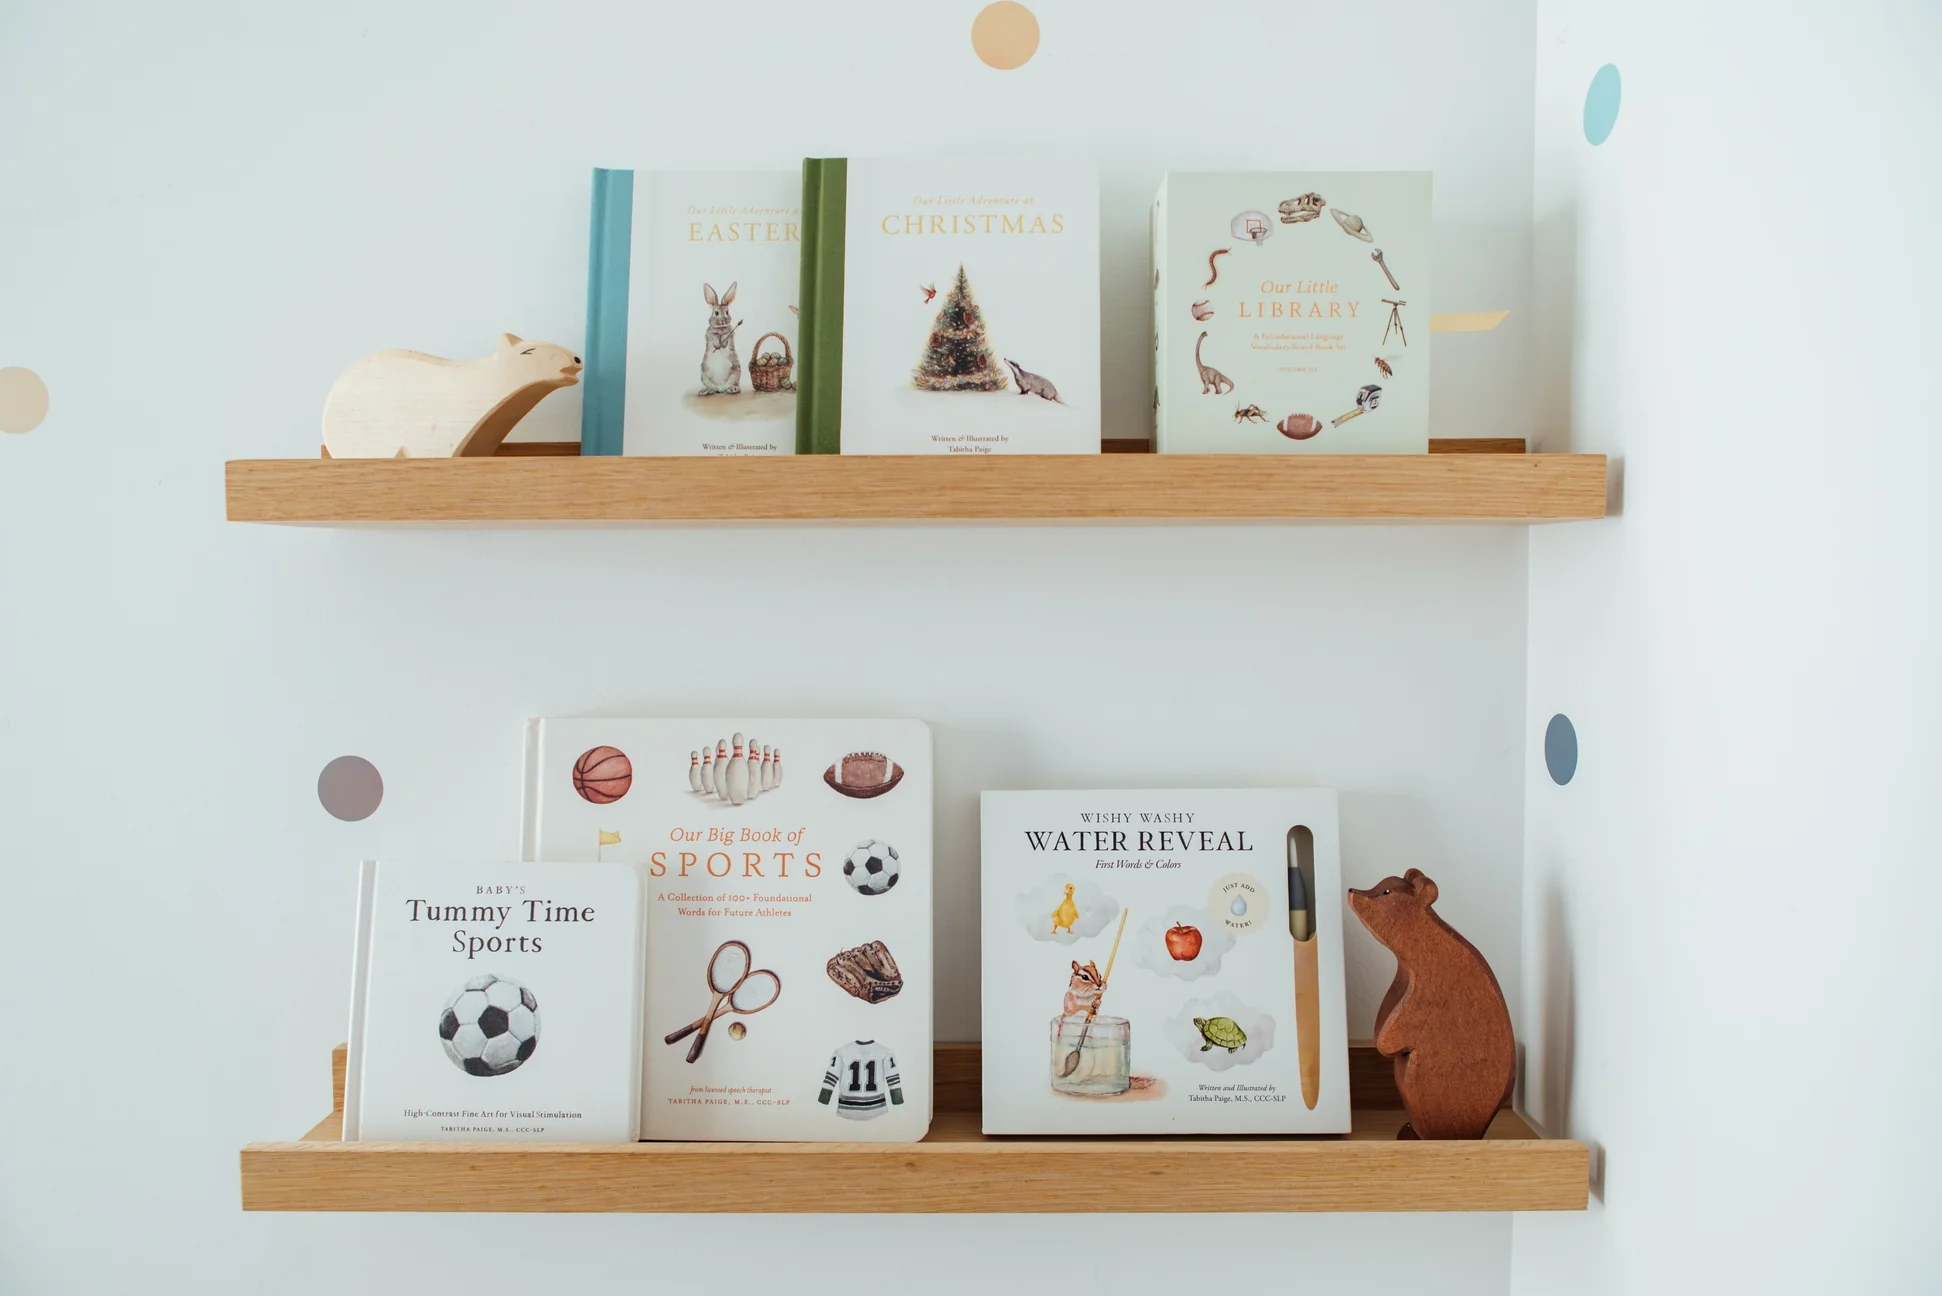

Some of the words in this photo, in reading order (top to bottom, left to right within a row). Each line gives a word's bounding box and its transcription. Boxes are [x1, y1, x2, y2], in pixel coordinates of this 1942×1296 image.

[912, 196, 934, 206] Our
[938, 196, 964, 206] Little
[968, 196, 1020, 206] Adventure
[881, 214, 1065, 235] CHRISTMAS
[688, 222, 801, 242] EASTER
[1260, 280, 1292, 294] Our
[1297, 280, 1338, 294] Little
[1238, 301, 1361, 318] LIBRARY
[975, 446, 992, 454] Paige
[1080, 813, 1132, 823] WISHY
[1140, 813, 1196, 823] WASHY
[670, 828, 703, 843] Our
[707, 828, 735, 846] Big
[739, 828, 782, 843] Book
[787, 827, 806, 846] of
[1024, 831, 1128, 852] WATER
[1138, 831, 1254, 852] REVEAL
[650, 852, 822, 878] SPORTS
[1095, 859, 1114, 869] First
[1116, 859, 1143, 869] Words
[1144, 859, 1154, 869] &
[1155, 859, 1182, 869] Colors
[476, 886, 526, 895] BABY'S
[1222, 883, 1238, 893] JUST
[1240, 884, 1255, 892] ADD
[657, 893, 665, 902] A
[667, 893, 714, 902] Collection
[716, 893, 727, 902] of
[753, 894, 812, 903] Foundational
[406, 899, 512, 930] Tummy
[522, 900, 595, 922] Time
[678, 908, 706, 917] Words
[708, 908, 722, 917] for
[724, 908, 753, 917] Future
[756, 908, 792, 917] Athletes
[1225, 919, 1252, 928] WATER!
[452, 930, 542, 960] Sports
[848, 1060, 878, 1092] 11
[689, 1086, 704, 1094] from
[728, 1086, 745, 1095] speech
[747, 1086, 772, 1095] therapist
[1269, 1084, 1276, 1093] by
[1214, 1095, 1232, 1103] Paige,
[404, 1110, 460, 1118] High-Contrast
[495, 1110, 508, 1118] for
